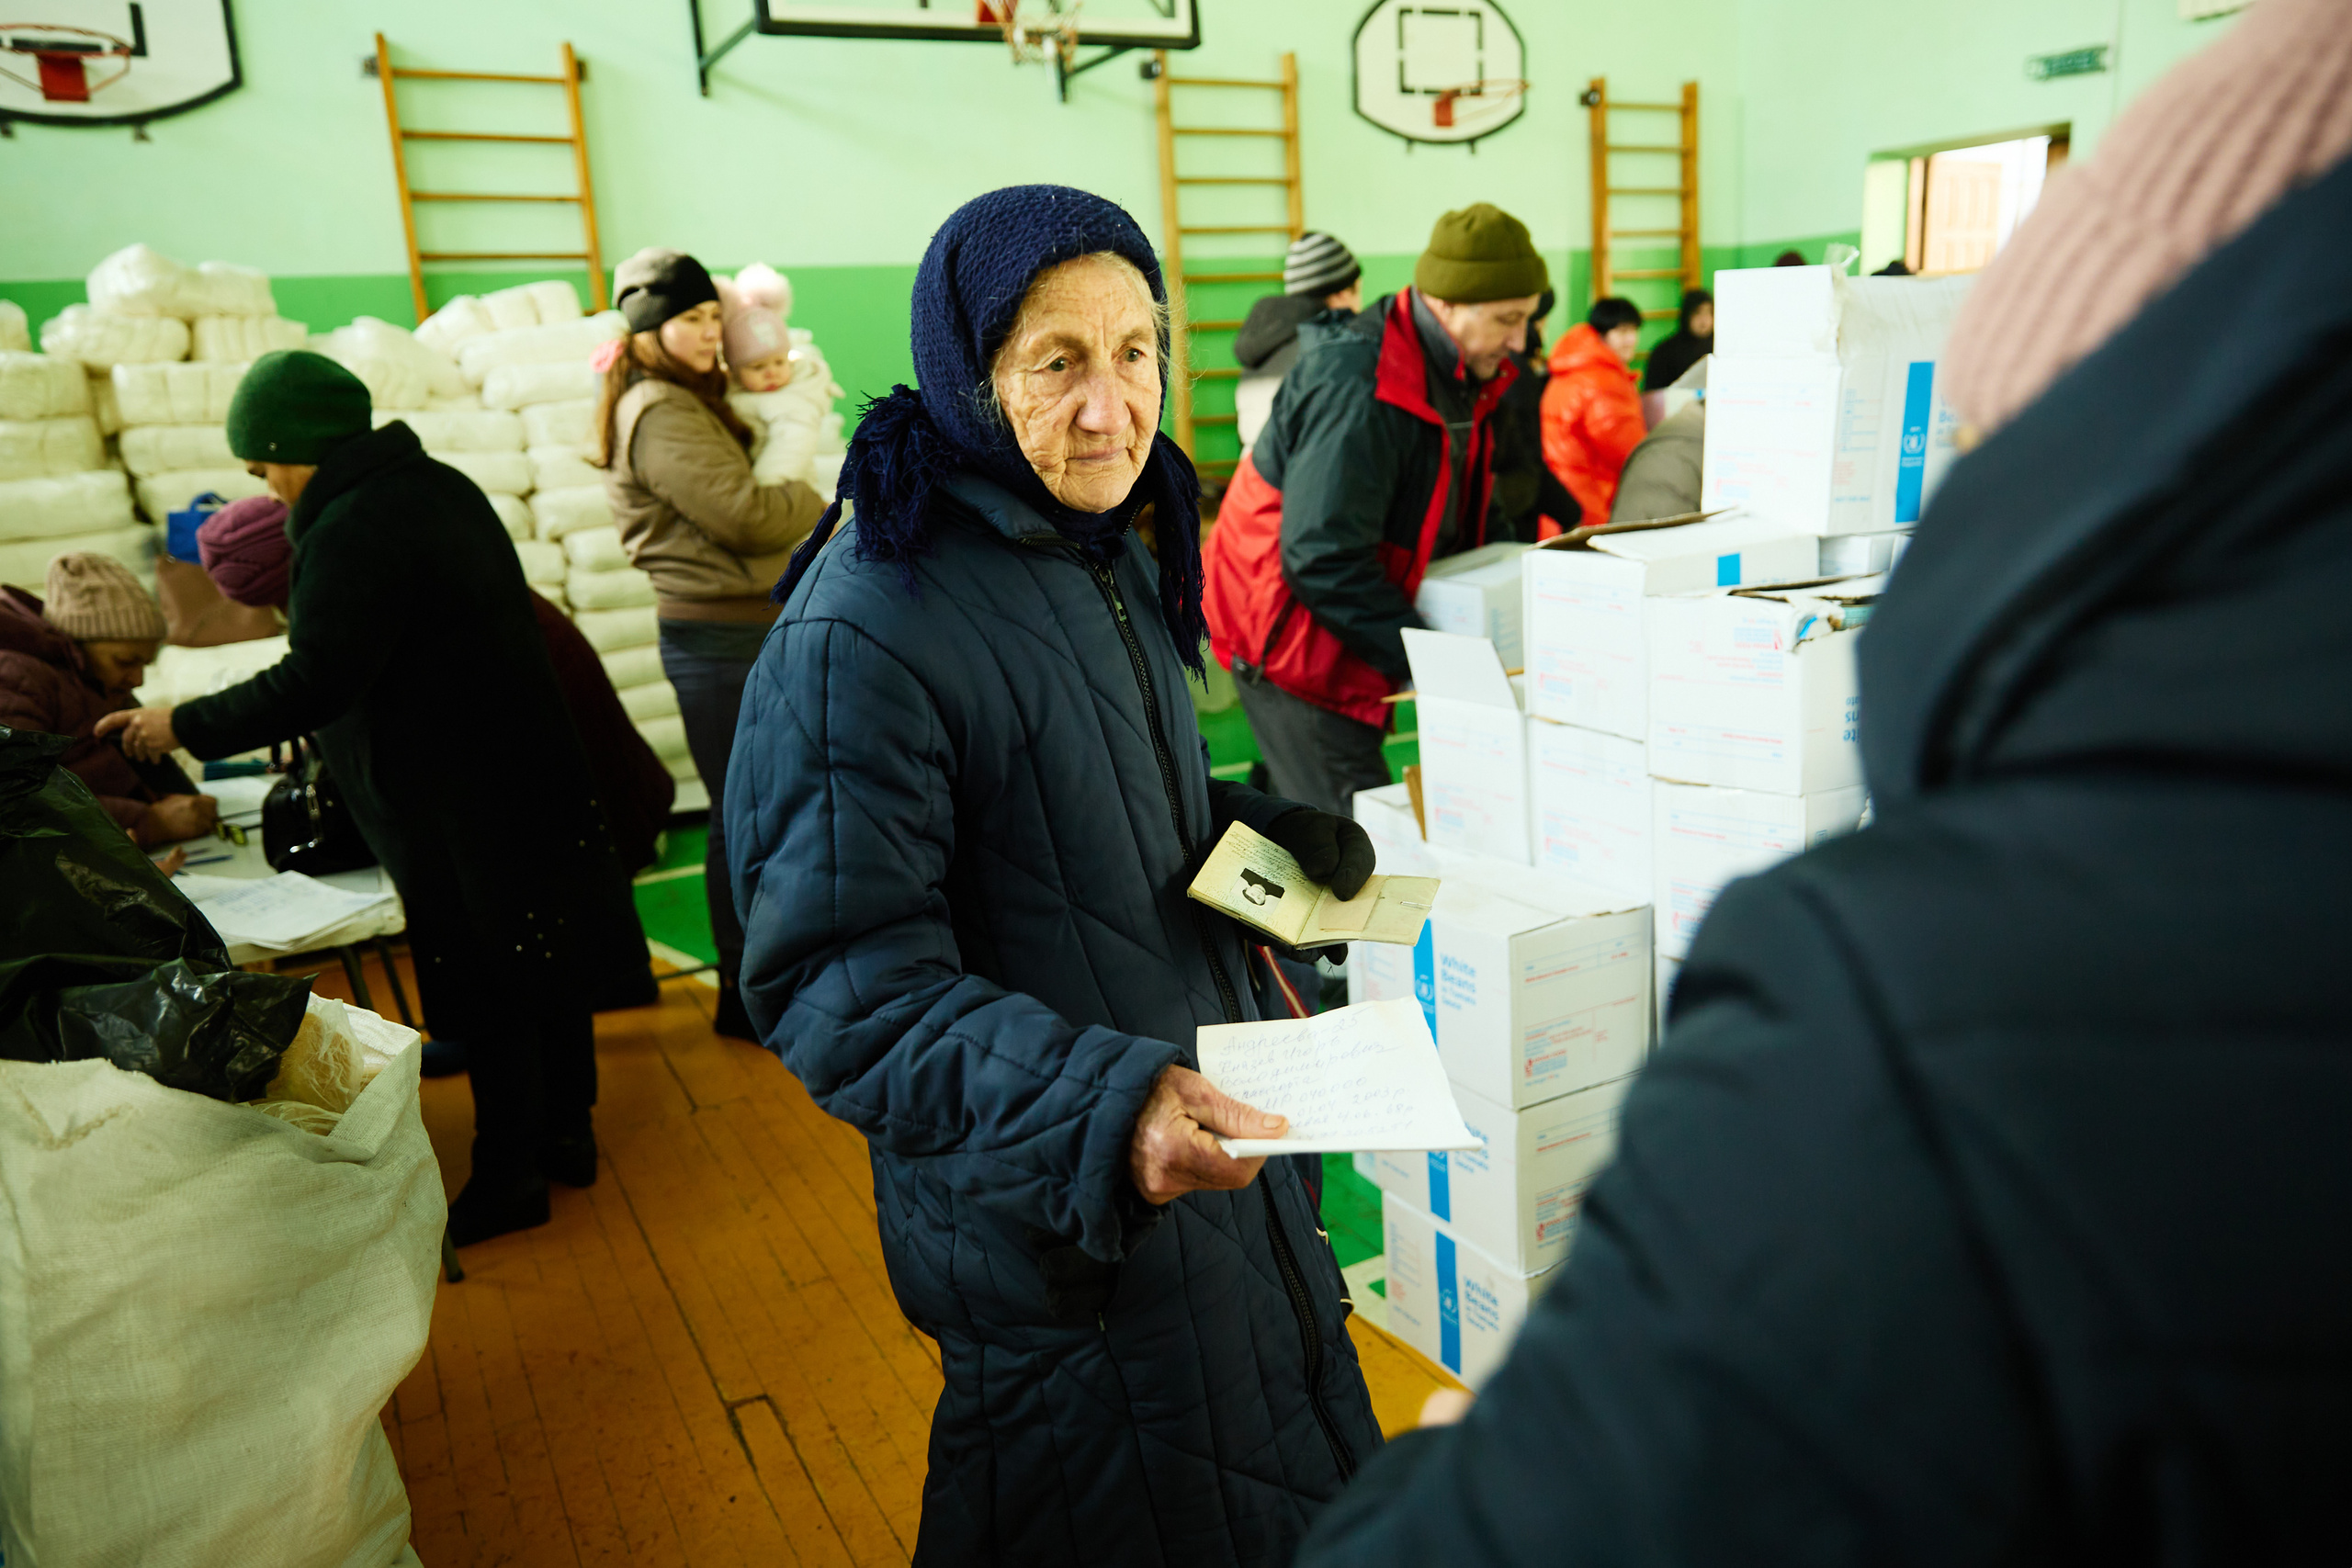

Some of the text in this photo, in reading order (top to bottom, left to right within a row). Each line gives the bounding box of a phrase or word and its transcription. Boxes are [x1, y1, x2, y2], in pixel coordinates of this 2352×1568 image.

[1440, 953, 1477, 977] White
[1441, 968, 1477, 994] Beans
[1463, 1275, 1499, 1306] White
[1464, 1290, 1499, 1322] Beans
